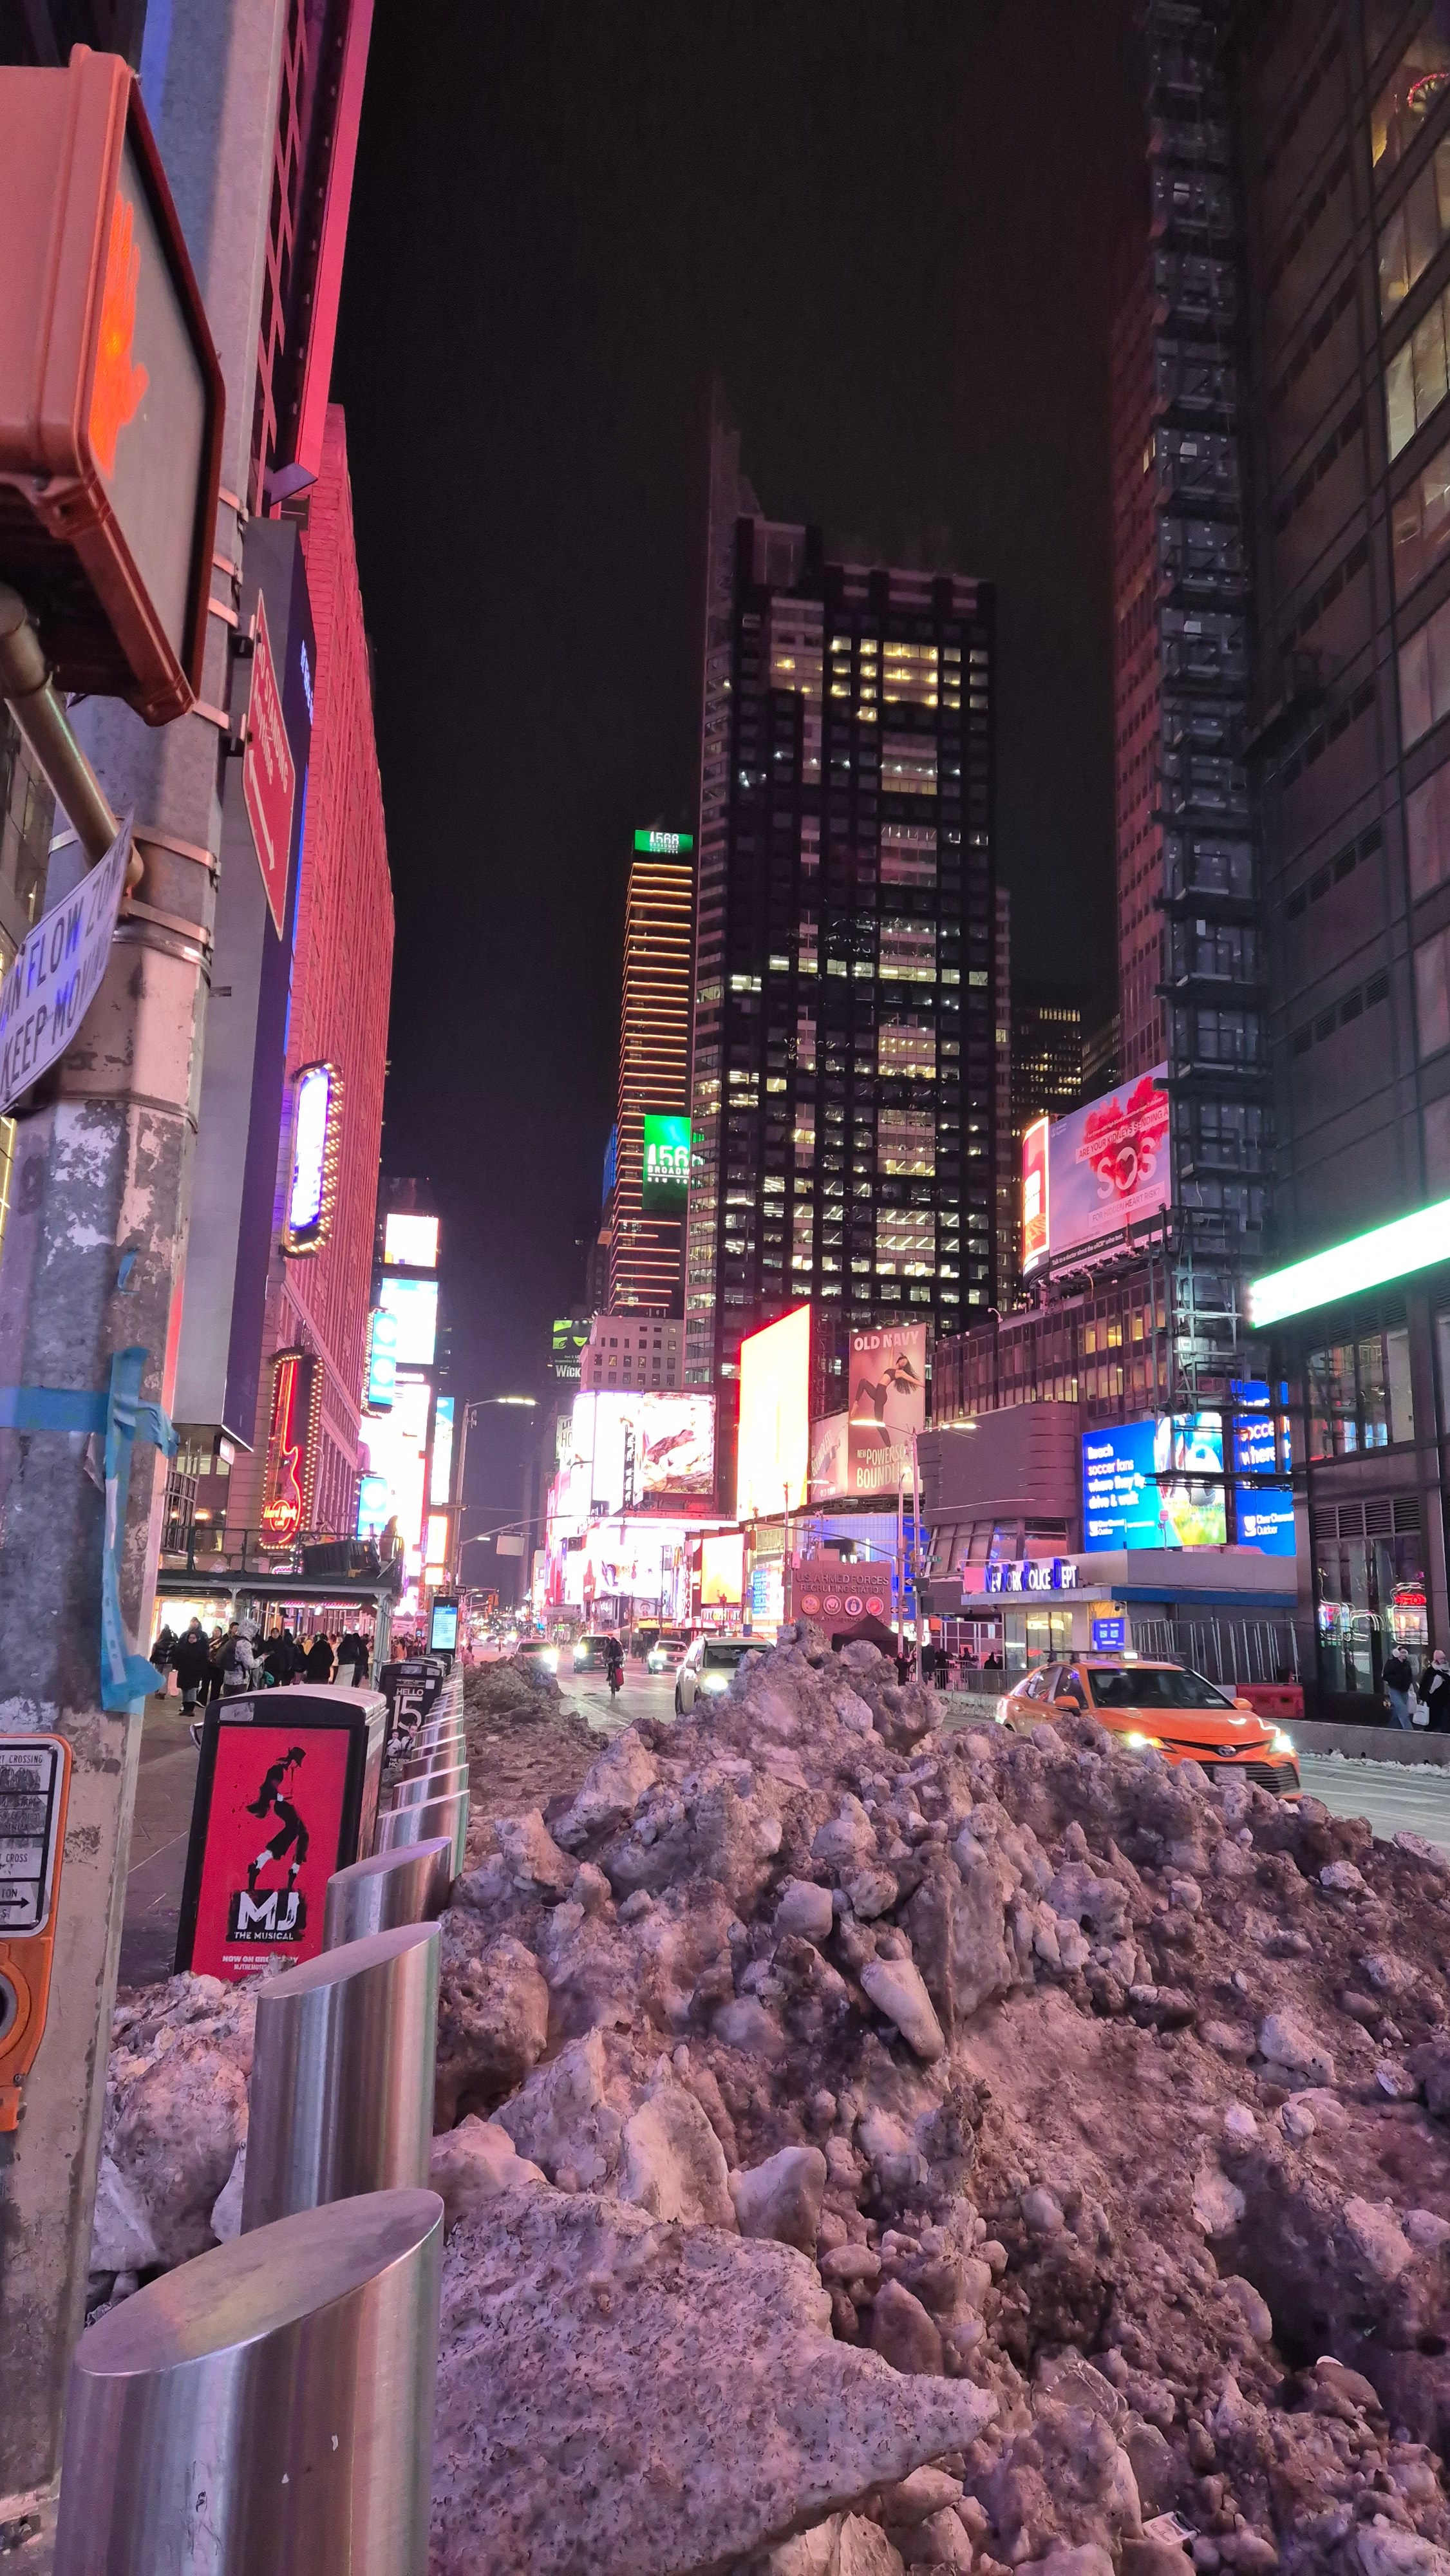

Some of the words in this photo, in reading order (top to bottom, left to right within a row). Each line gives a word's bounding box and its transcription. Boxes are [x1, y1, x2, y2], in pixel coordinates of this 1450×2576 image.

[264, 667, 288, 794] STANDING
[650, 831, 679, 845] 1568
[26, 896, 84, 998] FLOW
[1, 1004, 48, 1090] KEEP
[1078, 1148, 1090, 1159] ARE
[1090, 1138, 1107, 1152] YOUR
[1107, 1124, 1133, 1145] KIDNEYS
[1133, 1110, 1163, 1132] SENDING
[1097, 1137, 1156, 1199] SOS
[1092, 1211, 1104, 1222] FOR
[1104, 1203, 1124, 1218] HIDDEN
[1125, 1196, 1144, 1210] HEART
[854, 1336, 880, 1351] OLD
[883, 1331, 919, 1349] NAVY
[857, 1449, 867, 1459] NEW
[1088, 1443, 1114, 1460] Reach
[1088, 1463, 1115, 1476] soccer
[1116, 1459, 1135, 1472] fans
[1088, 1479, 1114, 1493] where
[812, 1573, 850, 1584] ARMED
[852, 1576, 890, 1586] FORCES
[985, 1562, 1001, 1593] NEW
[1002, 1564, 1022, 1593] YORK
[1022, 1560, 1051, 1592] POLICE
[1053, 1557, 1077, 1590] DEPT
[800, 1584, 849, 1593] RECRUITING
[851, 1585, 885, 1594] STATION
[396, 1688, 424, 1696] HELLO
[393, 1695, 423, 1732] 15
[9, 1754, 42, 1763] CROSSING
[6, 1853, 28, 1862] CROSS
[237, 1891, 300, 1931] MJ
[234, 1931, 251, 1940] THE
[254, 1932, 294, 1940] MUSICAL
